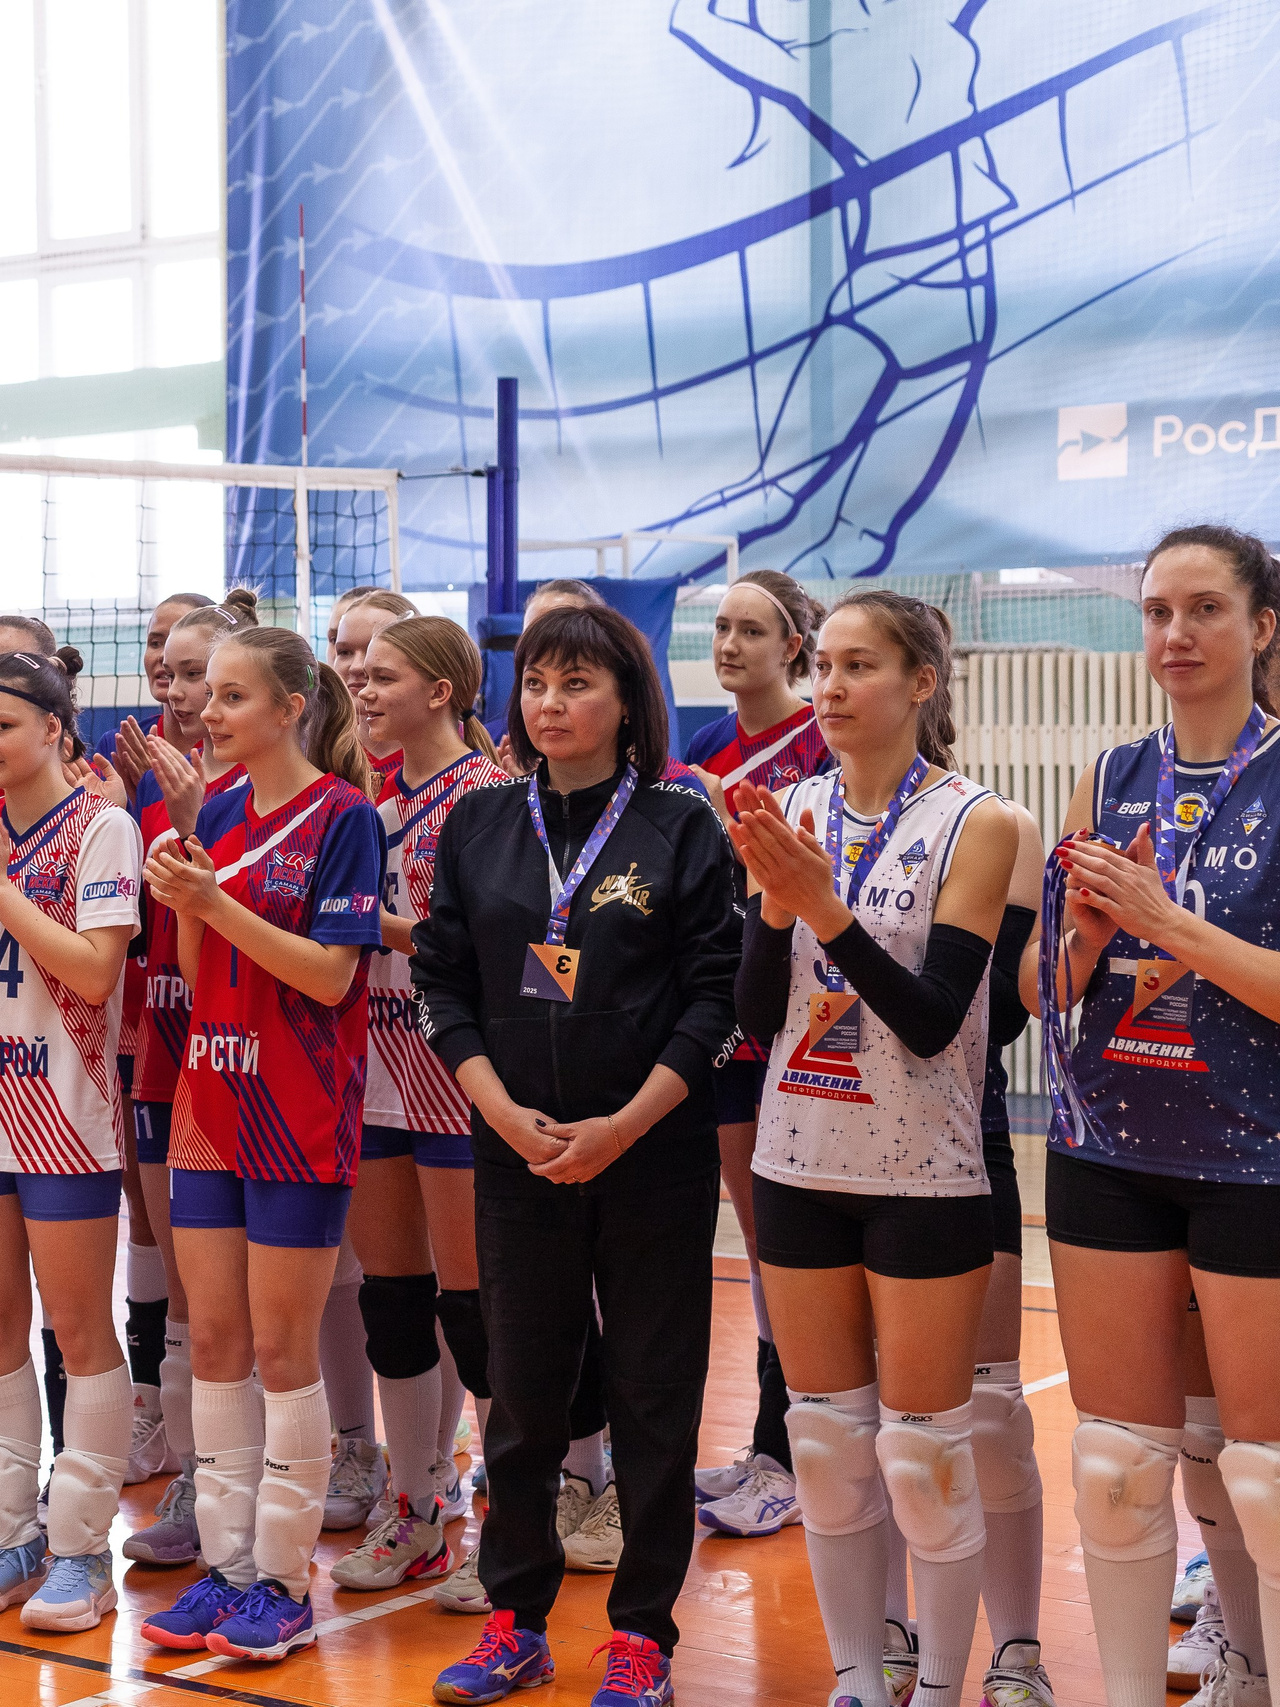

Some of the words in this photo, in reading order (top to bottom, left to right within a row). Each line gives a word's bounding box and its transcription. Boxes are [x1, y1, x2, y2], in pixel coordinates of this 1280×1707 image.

[1153, 406, 1280, 459] РосД
[650, 781, 682, 793] AIR
[1117, 801, 1151, 815] ВФВ
[27, 875, 60, 890] ИСКРА
[271, 865, 306, 886] ИСКРА
[600, 875, 642, 891] NIKE
[31, 888, 56, 896] САМАРА
[83, 882, 115, 899] СШОР
[274, 880, 300, 891] САМАРА
[320, 898, 349, 912] ШОР
[362, 895, 375, 912] 17
[1143, 967, 1160, 991] 3
[523, 986, 538, 995] 2025
[816, 1001, 831, 1022] 3
[1107, 1036, 1196, 1059] ДВИЖЕНИЕ
[1113, 1052, 1190, 1068] НЕФТЕПРОДУКТ
[781, 1069, 863, 1092] ДВИЖЕНИЕ
[787, 1085, 858, 1100] НЕФТЕПРОДУКТ
